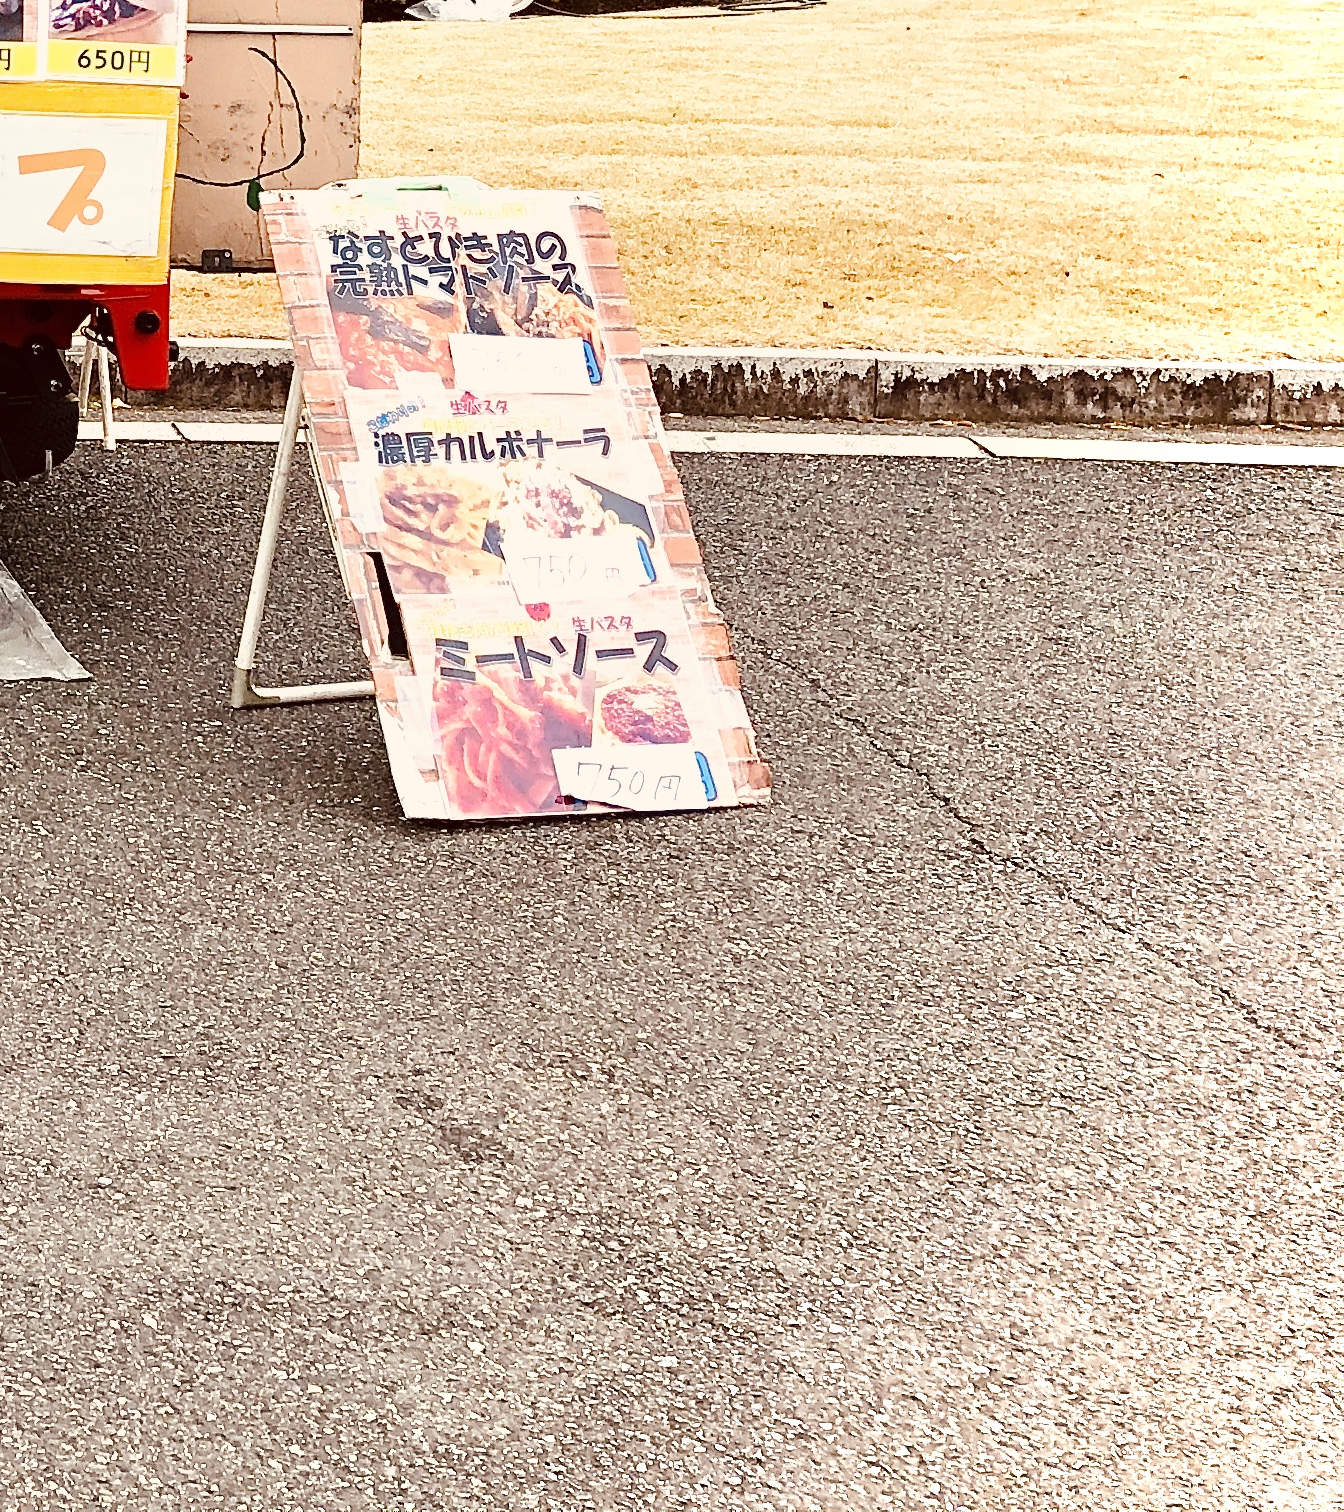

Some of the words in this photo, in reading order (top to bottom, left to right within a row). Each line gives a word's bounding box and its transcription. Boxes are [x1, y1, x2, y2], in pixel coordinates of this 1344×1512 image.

[77, 48, 151, 73] 650円
[396, 212, 459, 231] 生パスタ
[330, 262, 587, 297] 完熟トマトソース
[373, 427, 612, 465] 濃厚カルボナーラ
[523, 553, 623, 588] 750円
[572, 616, 634, 633] 生パスタ
[435, 629, 680, 681] ミートソース
[577, 762, 682, 801] 750円
